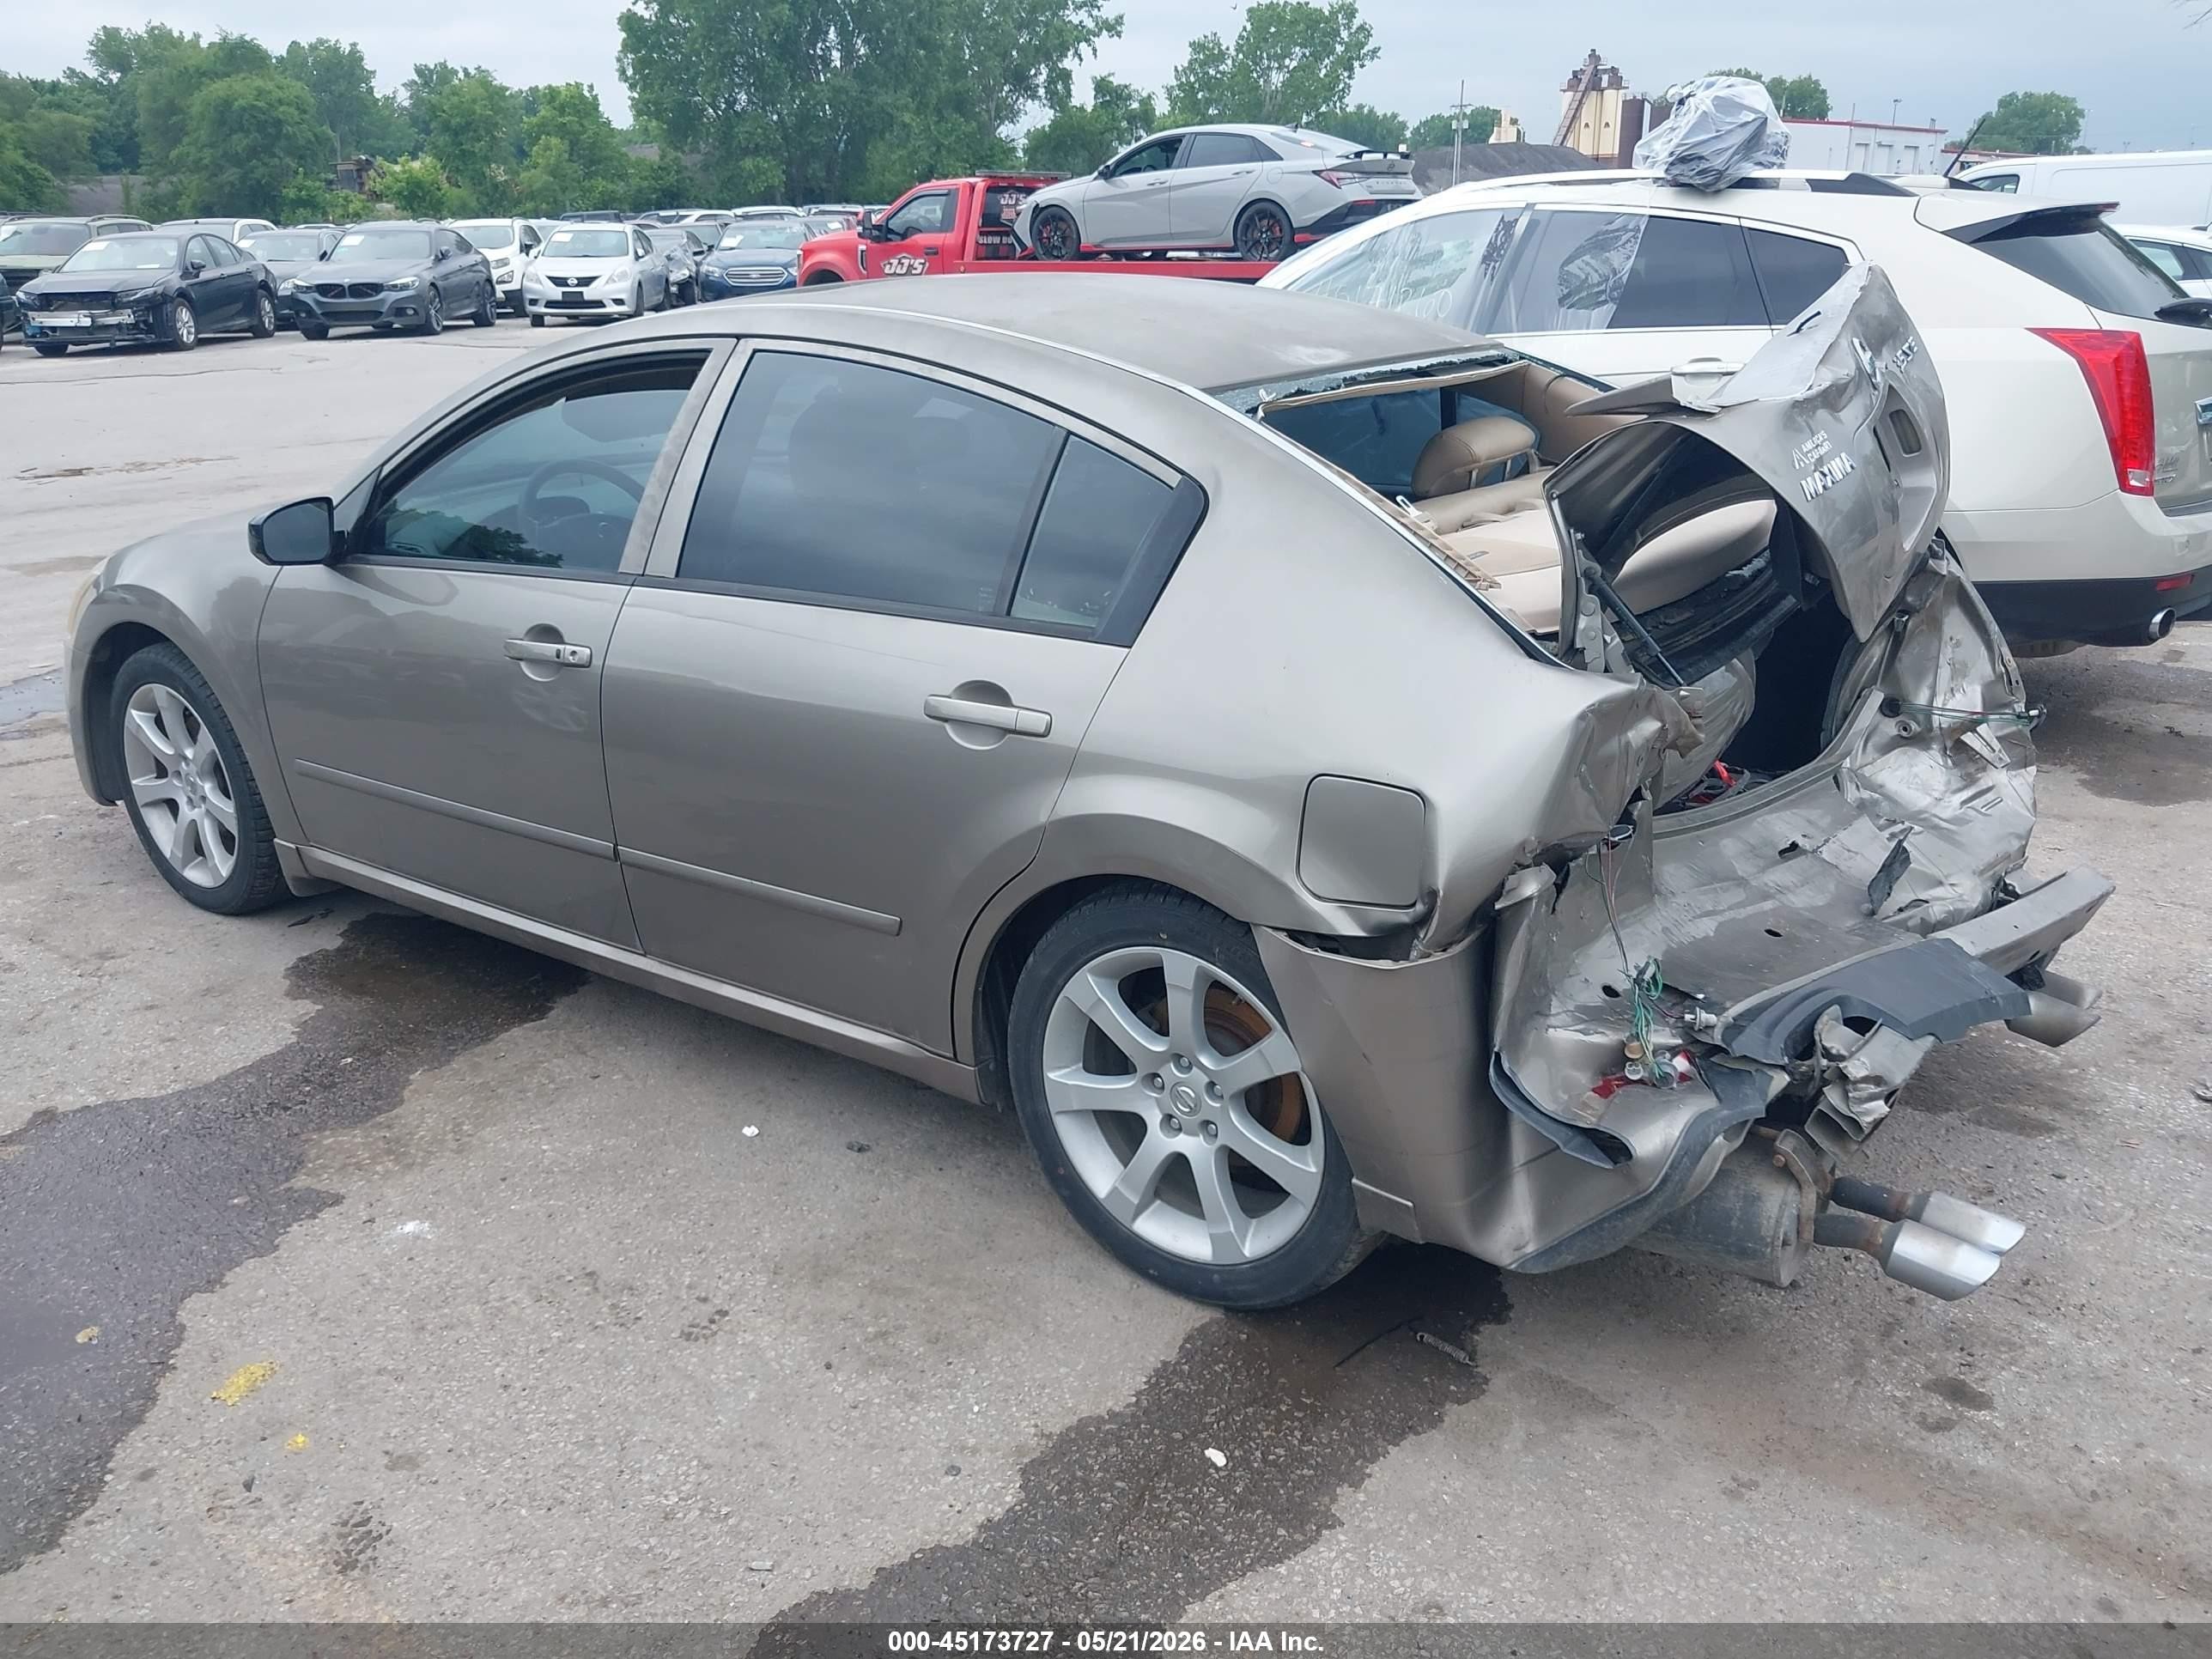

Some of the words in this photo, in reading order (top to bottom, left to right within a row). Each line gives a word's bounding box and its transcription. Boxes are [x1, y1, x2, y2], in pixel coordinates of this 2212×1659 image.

[978, 234, 1001, 245] SLOW
[884, 258, 926, 275] JJ'S
[1800, 452, 1856, 502] MAXIMA
